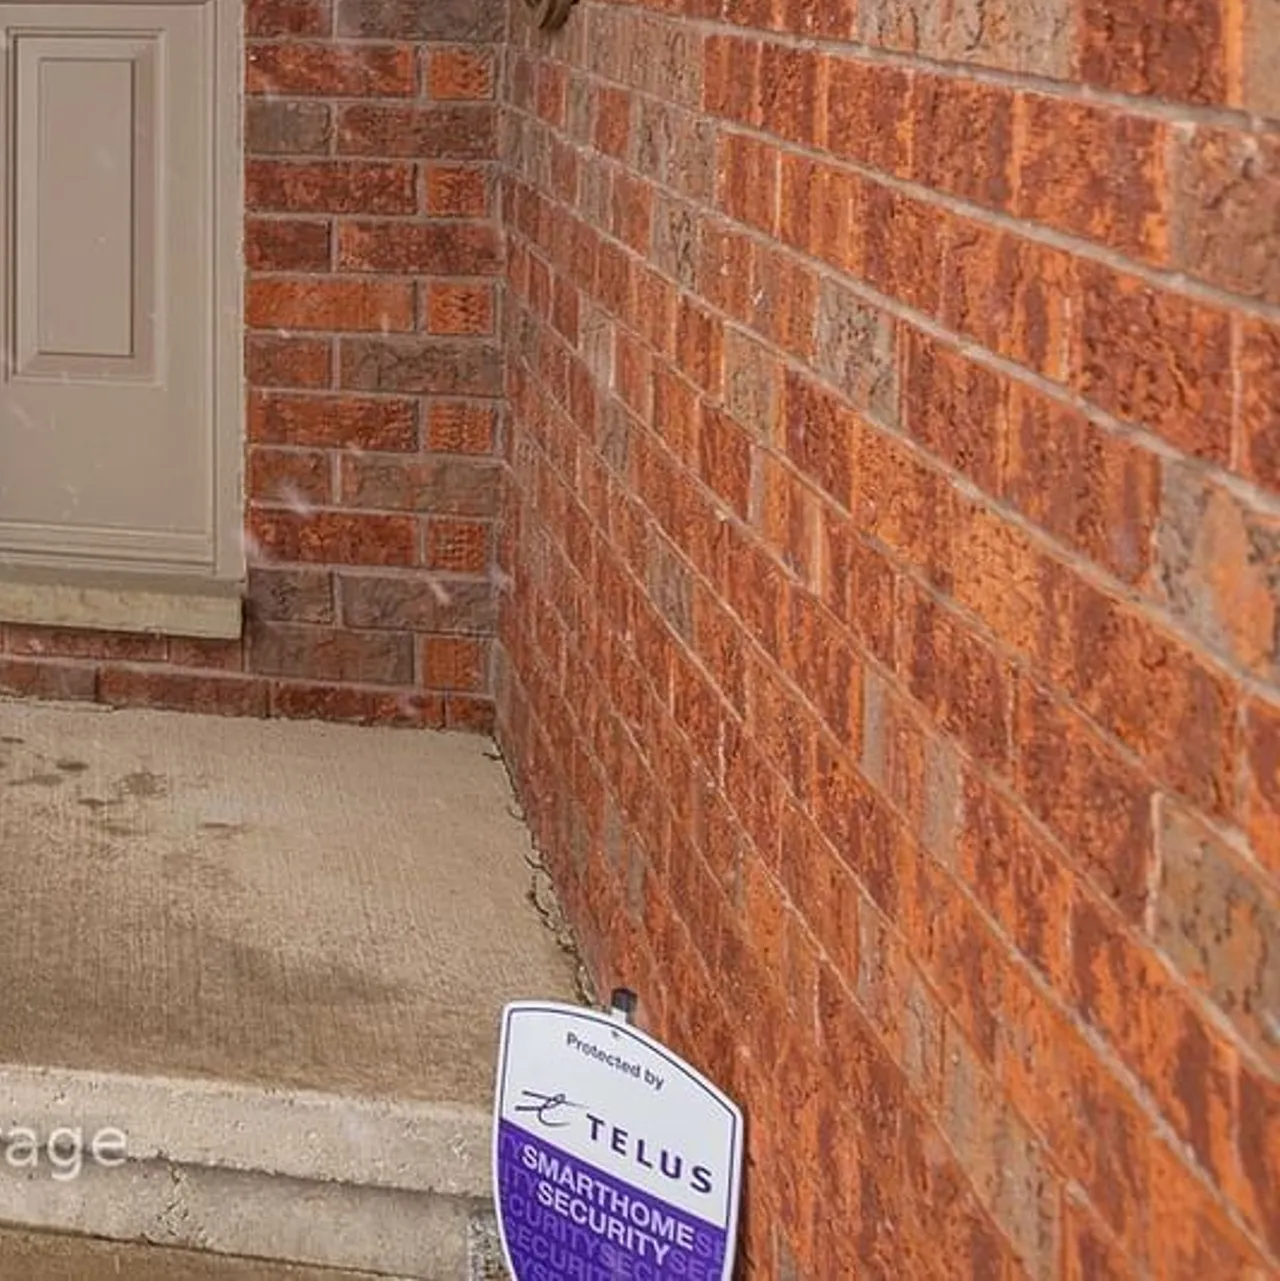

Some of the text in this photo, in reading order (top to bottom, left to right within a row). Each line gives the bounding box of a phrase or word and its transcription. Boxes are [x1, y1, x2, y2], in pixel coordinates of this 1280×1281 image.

[567, 1031, 665, 1090] Protected by
[586, 1113, 713, 1194] TELUS
[522, 1144, 694, 1251] SMARTHOME
[536, 1181, 670, 1266] SECURITY
